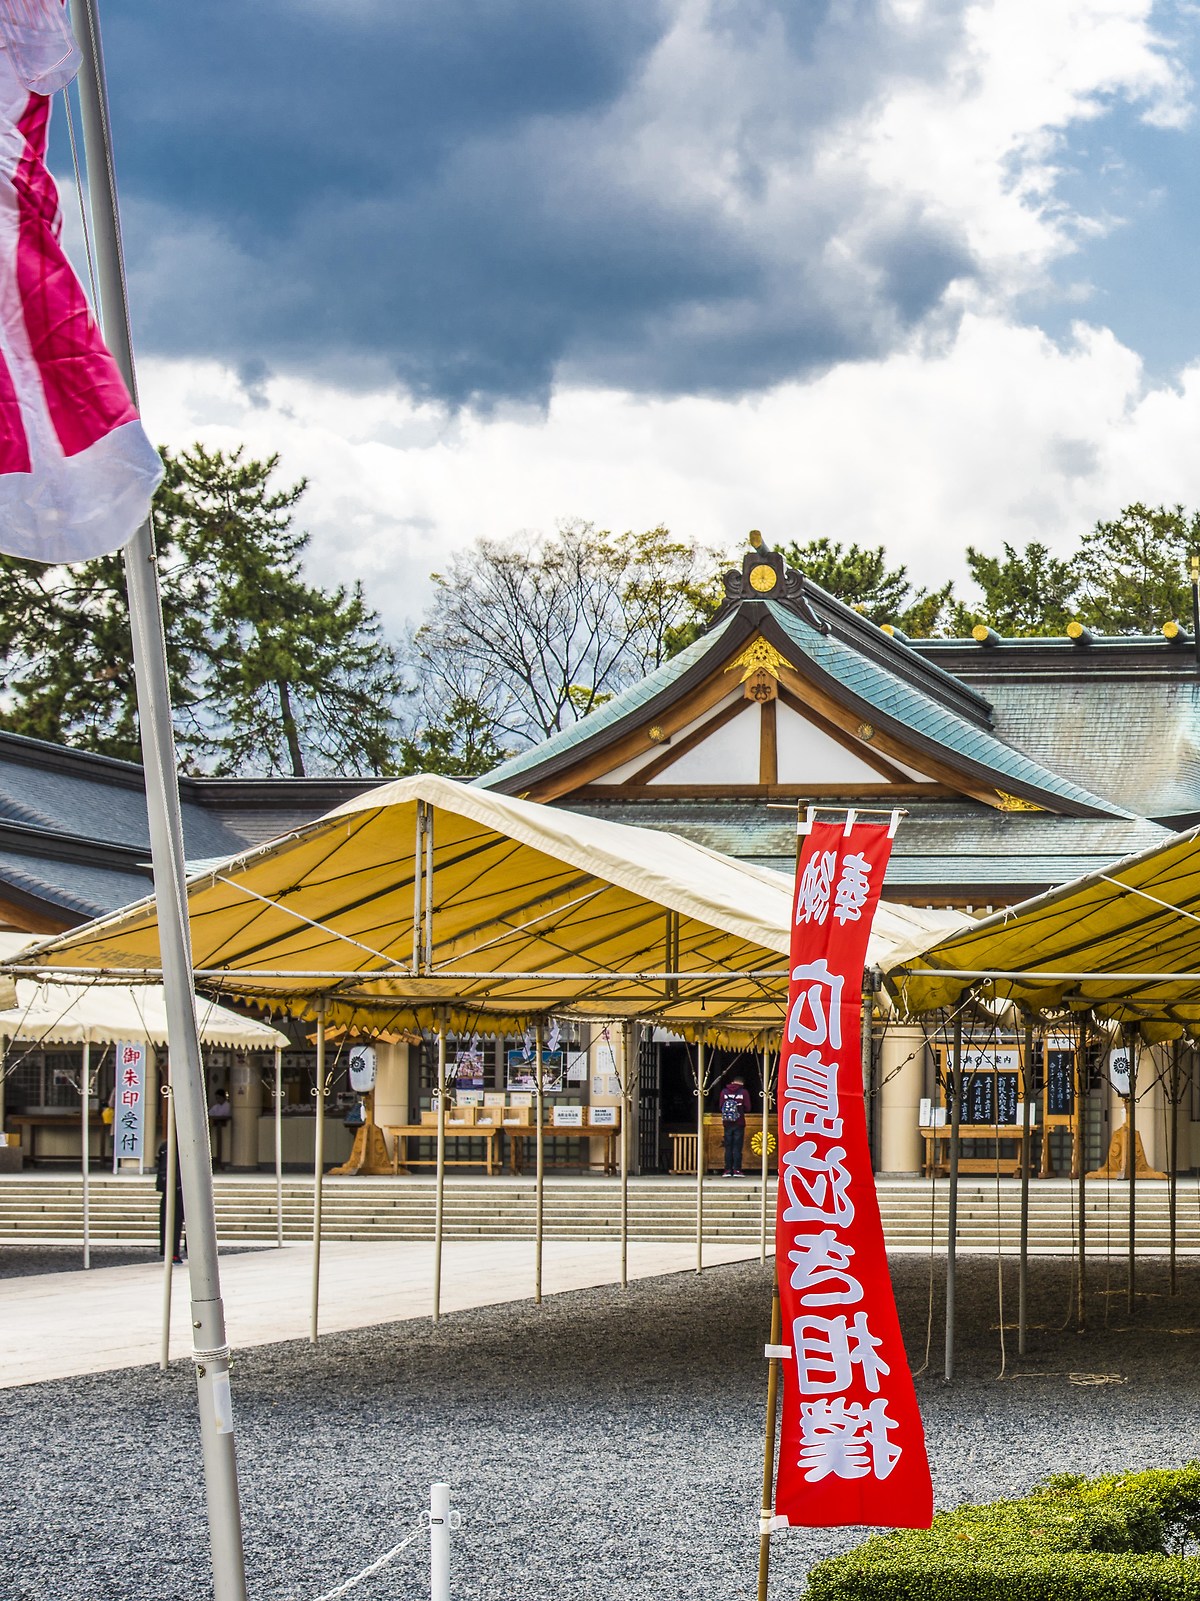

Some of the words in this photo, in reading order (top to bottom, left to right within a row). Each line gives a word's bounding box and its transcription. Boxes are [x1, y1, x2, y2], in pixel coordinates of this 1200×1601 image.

[121, 1046, 141, 1152] 御朱印受付
